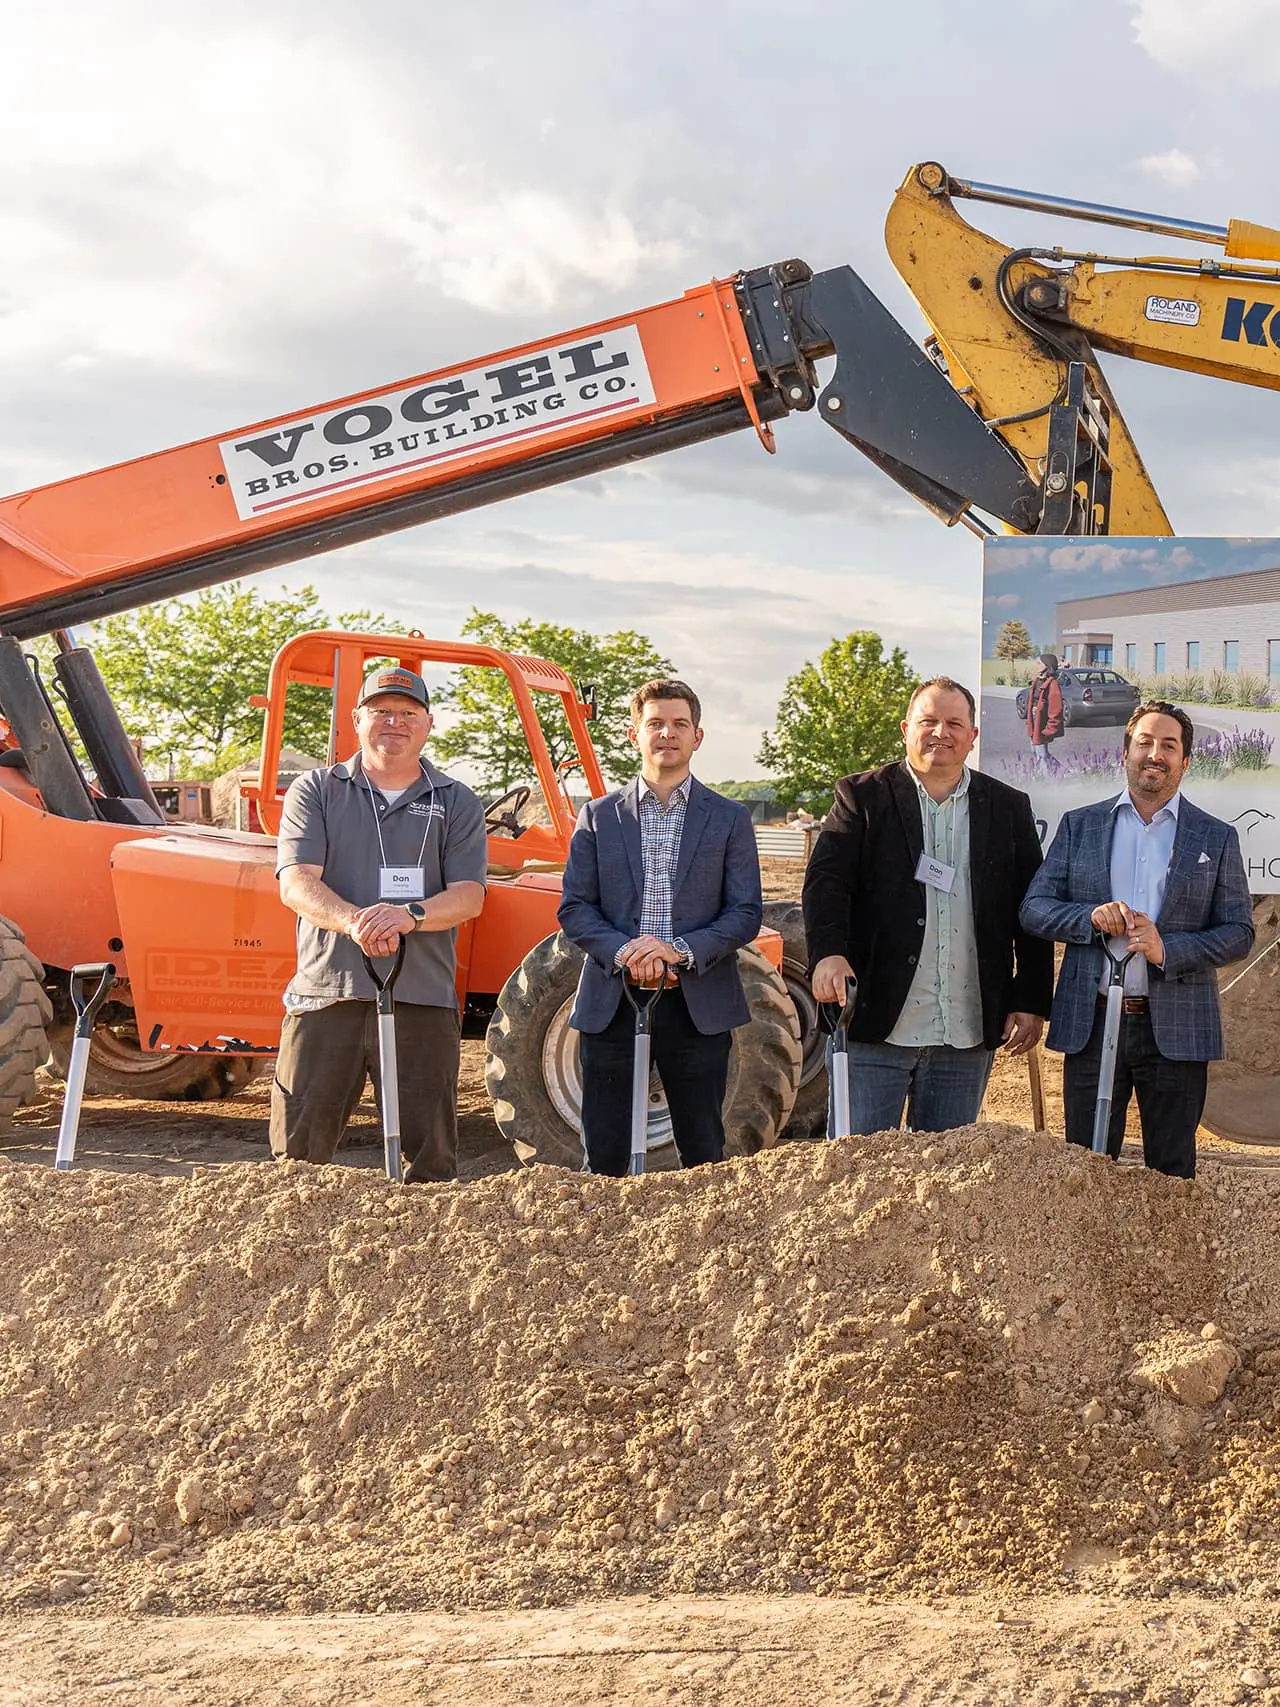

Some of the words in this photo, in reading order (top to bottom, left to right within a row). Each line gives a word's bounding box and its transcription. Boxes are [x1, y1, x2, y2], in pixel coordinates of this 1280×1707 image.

[1151, 298, 1197, 313] ROLAND
[235, 340, 630, 467] VOGEL
[245, 454, 359, 497] BROS.
[369, 393, 567, 461] BUILDING
[579, 376, 637, 401] CO.
[392, 874, 410, 882] Dan
